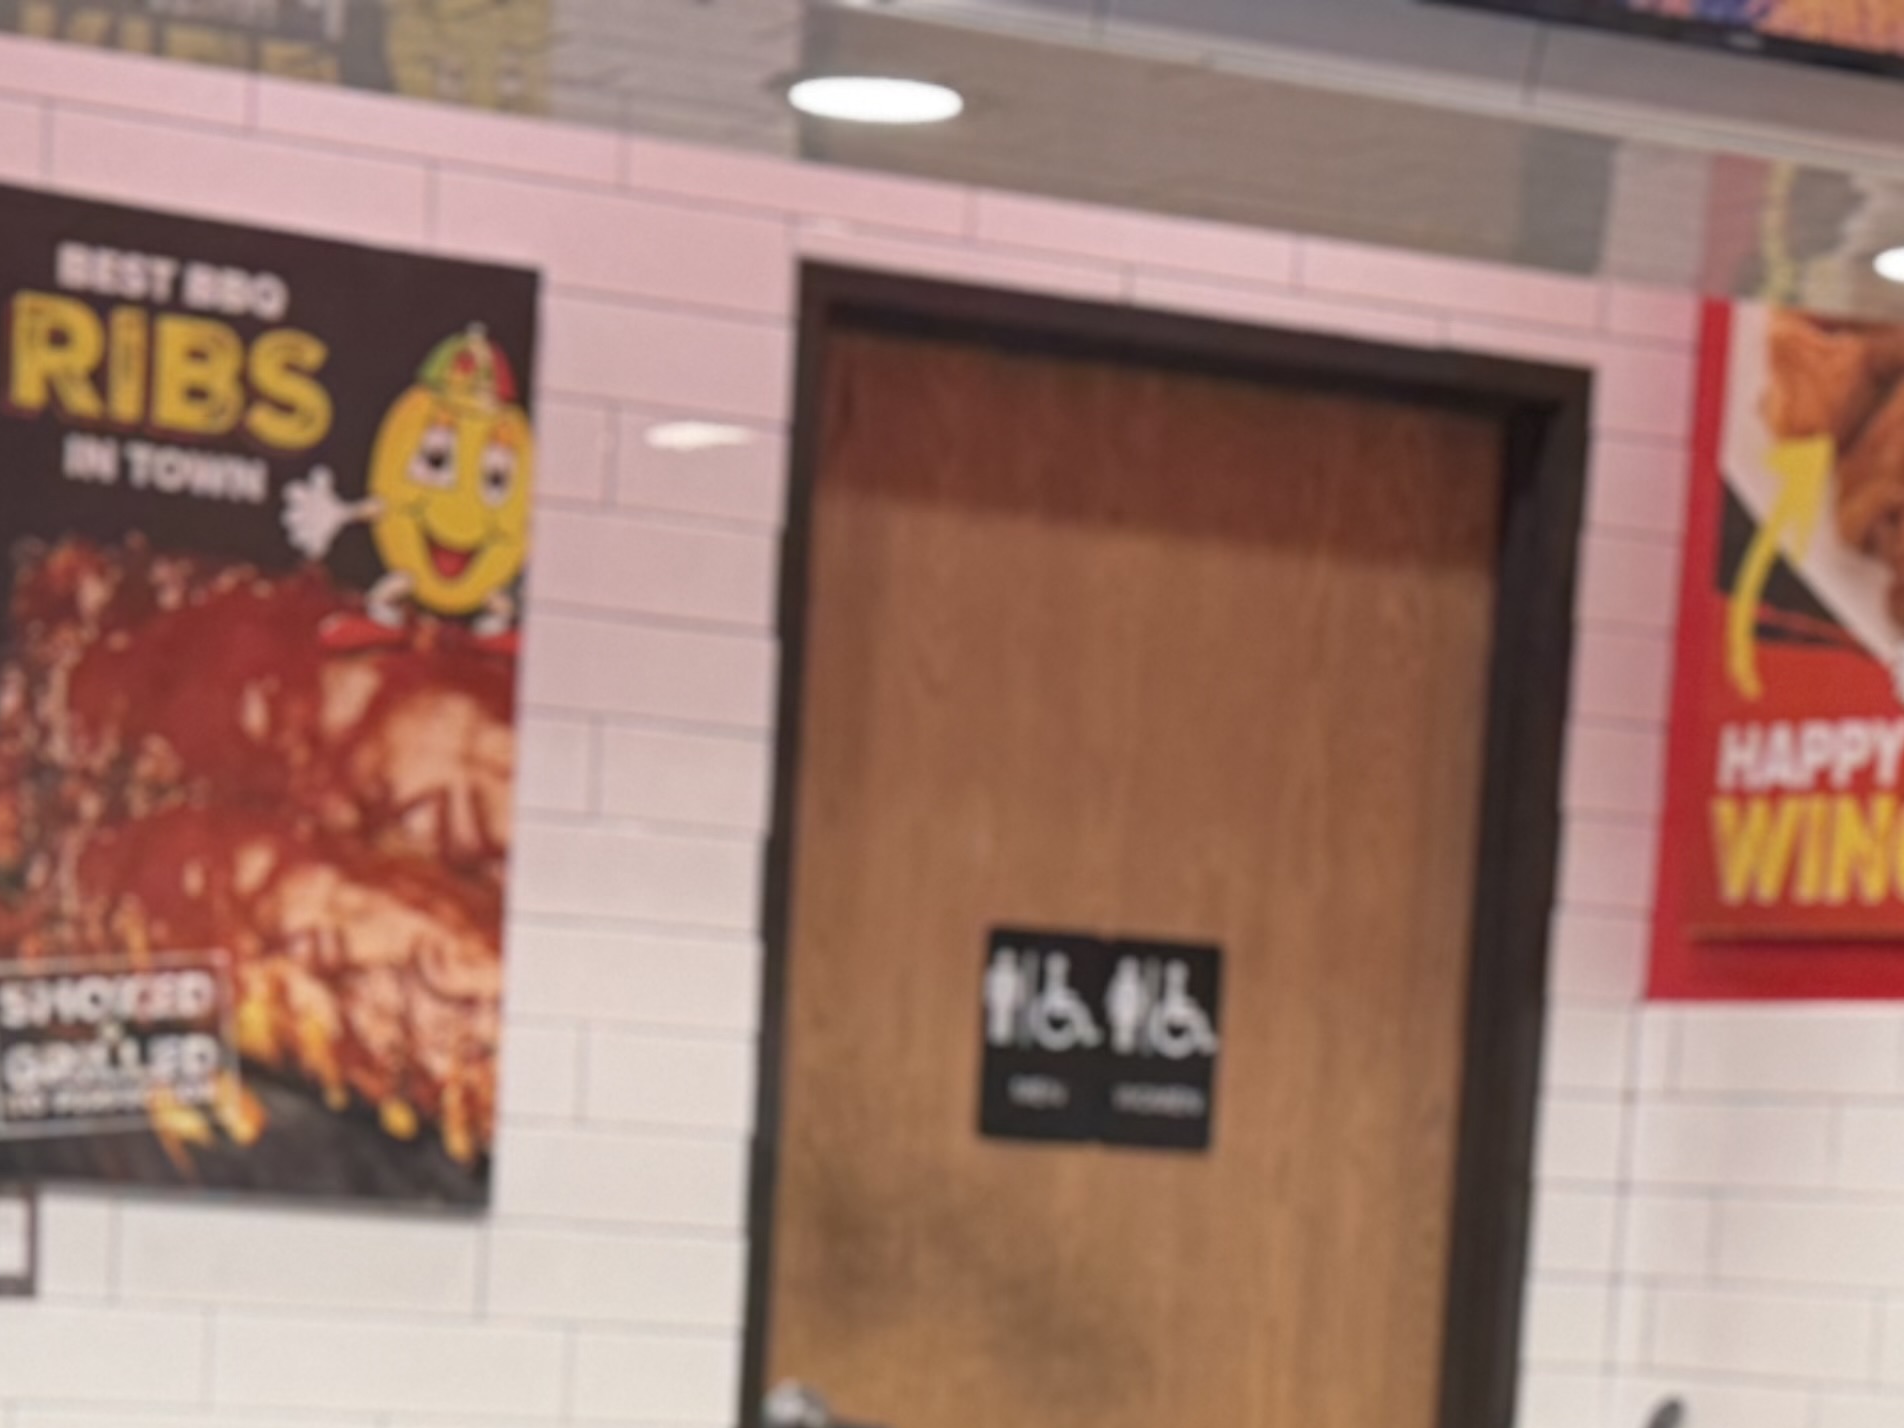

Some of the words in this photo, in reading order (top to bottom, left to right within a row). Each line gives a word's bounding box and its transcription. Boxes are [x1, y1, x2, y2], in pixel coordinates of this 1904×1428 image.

[55, 241, 178, 301] BEST
[8, 289, 332, 449] RIBS
[63, 433, 117, 482] IN
[123, 440, 268, 502] TOWN
